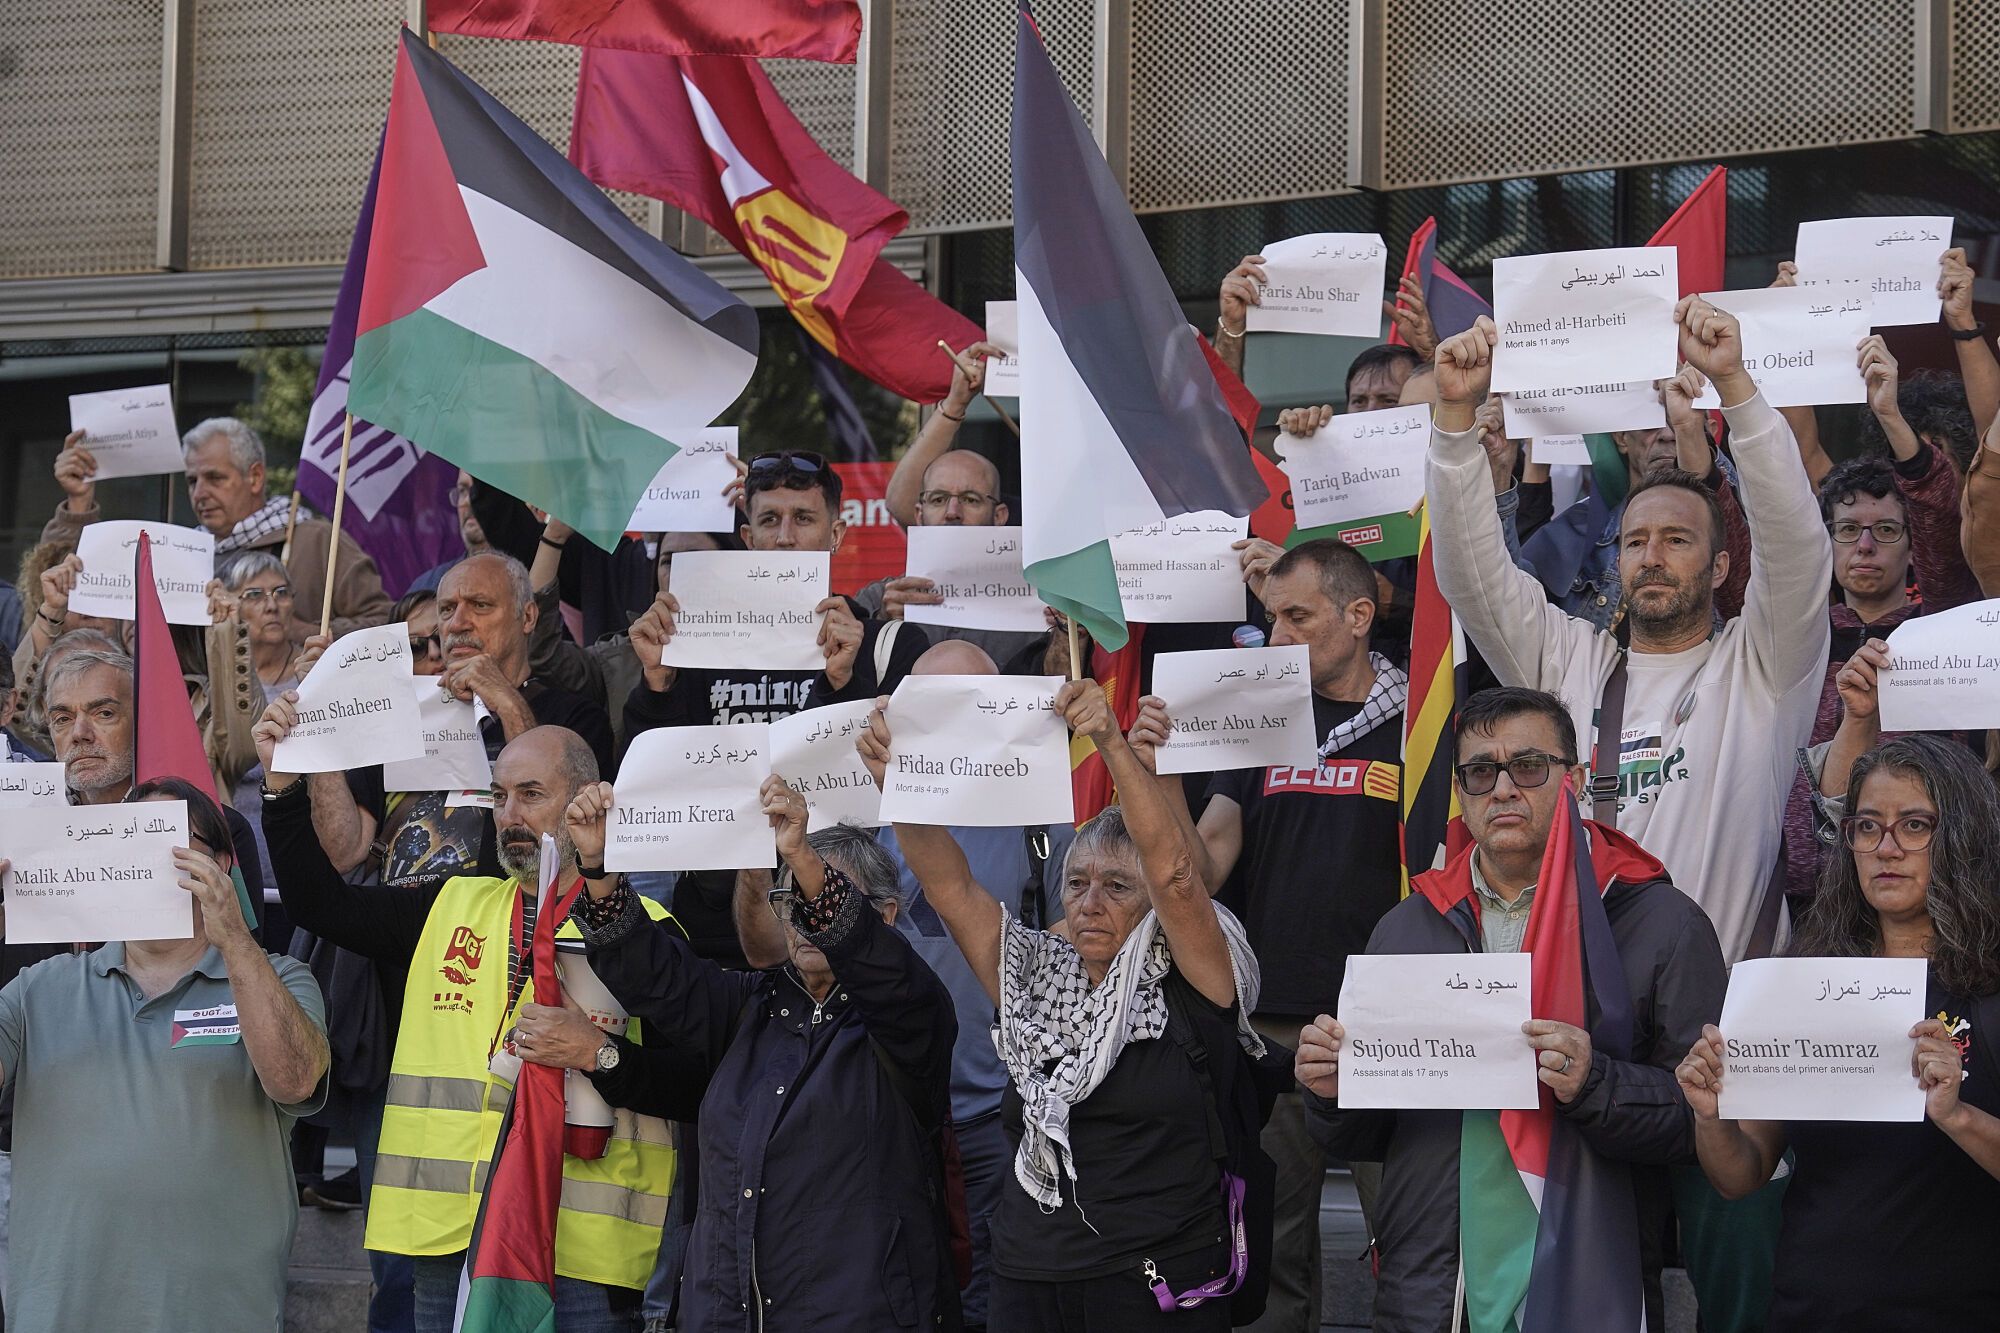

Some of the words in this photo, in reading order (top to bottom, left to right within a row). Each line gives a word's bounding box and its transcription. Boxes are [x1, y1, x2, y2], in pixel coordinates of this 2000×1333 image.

[1919, 229, 1941, 242] حلا
[1561, 264, 1626, 291] الهربيطي
[1632, 263, 1665, 278] احمد
[1257, 284, 1293, 299] Faris
[1295, 285, 1325, 301] Abu
[1327, 287, 1361, 303] Shar
[1808, 303, 1834, 317] عبيد
[1839, 298, 1863, 318] شام
[1504, 318, 1551, 335] Ahmed
[1554, 312, 1627, 331] al-Harbeiti
[1505, 339, 1524, 350] Mort
[1525, 339, 1537, 348] als
[1539, 338, 1549, 347] 11
[1550, 337, 1570, 347] anys
[1762, 349, 1815, 370] Obeid
[1514, 407, 1531, 415] Mort
[1549, 405, 1566, 414] anys
[1353, 424, 1385, 439] بدوان
[1388, 417, 1423, 436] طارق
[1299, 474, 1340, 493] Tariq
[1341, 466, 1401, 486] Badwan
[648, 487, 701, 501] Udwan
[1303, 498, 1319, 507] Mort
[1171, 522, 1201, 536] حسن
[1206, 523, 1238, 534] محمد
[1341, 528, 1380, 544] CCOO
[1165, 560, 1207, 571] Hassan
[1209, 559, 1226, 571] al-
[80, 572, 132, 589] Suhaib
[746, 566, 771, 582] عابد
[776, 565, 819, 584] إبراهيم
[963, 582, 1032, 598] al-Ghoul
[1134, 593, 1144, 601] als
[1146, 593, 1155, 601] 13
[1155, 594, 1173, 602] anys
[676, 610, 732, 624] Ibrahim
[736, 610, 774, 628] Ishaq
[777, 610, 813, 624] Abed
[675, 630, 692, 638] Mort
[692, 631, 711, 639] quan
[712, 630, 730, 638] tenia
[737, 631, 752, 639] any
[338, 646, 372, 669] شاهين
[1889, 655, 1939, 671] Ahmed
[1942, 654, 1972, 669] Abu
[1976, 654, 2000, 672] Lay
[1215, 668, 1247, 683] عصر
[1253, 663, 1269, 681] ابو
[1275, 661, 1300, 680] نادر
[1889, 677, 1932, 687] Assassinat
[1932, 676, 1945, 686] als
[1947, 676, 1957, 685] 16
[1958, 676, 1978, 688] anys
[296, 707, 327, 725] man
[328, 696, 393, 720] Shaheen
[976, 696, 1018, 715] غريب
[288, 730, 305, 739] Mort
[306, 729, 317, 737] als
[317, 727, 322, 735] 2
[322, 726, 337, 736] anys
[838, 718, 854, 737] ابو
[1168, 716, 1218, 735] Nader
[1222, 714, 1255, 731] Abu
[1259, 714, 1288, 730] Asr
[1166, 739, 1208, 750] Assassinat
[1209, 738, 1221, 747] als
[1222, 737, 1231, 746] 14
[1232, 737, 1250, 746] anys
[726, 748, 758, 766] مريم
[1621, 750, 1660, 762] PALESTINA
[897, 754, 945, 775] Fidaa
[949, 756, 1029, 778] Ghareeb
[31, 780, 56, 796] يزن
[815, 773, 847, 791] Abu
[895, 783, 913, 793] Mort
[913, 784, 925, 794] als
[926, 785, 932, 793] 4
[932, 785, 950, 795] anys
[617, 805, 682, 825] Mariam
[687, 805, 736, 823] Krera
[66, 824, 114, 842] نصيرة
[119, 816, 139, 839] أبو
[143, 818, 177, 834] مالك
[616, 835, 633, 844] Mort
[633, 834, 644, 843] als
[645, 834, 650, 842] 9
[651, 834, 670, 844] anys
[13, 868, 60, 885] Malik
[62, 867, 97, 884] Abu
[99, 865, 154, 882] Nasira
[15, 888, 34, 898] Mort
[34, 888, 47, 898] als
[48, 888, 54, 897] 9
[55, 888, 75, 898] anys
[1445, 972, 1469, 991] طه
[1474, 977, 1518, 995] سجود
[1815, 978, 1861, 1001] تمراز
[1867, 987, 1912, 1001] سمير
[433, 1002, 472, 1016] www.ugt.cat
[202, 1025, 241, 1034] PALESTIN
[1352, 1038, 1422, 1063] Sujoud
[1425, 1038, 1477, 1059] Taha
[1727, 1038, 1791, 1059] Samir
[1794, 1039, 1880, 1059] Tamraz
[1352, 1068, 1399, 1078] Assassinat
[1400, 1068, 1414, 1078] als
[1416, 1068, 1426, 1077] 17
[1428, 1069, 1449, 1079] anys
[1729, 1064, 1751, 1074] Mort
[1752, 1064, 1781, 1074] abans
[1782, 1064, 1797, 1074] del
[1798, 1064, 1828, 1076] primer
[1830, 1064, 1875, 1075] aniversari
